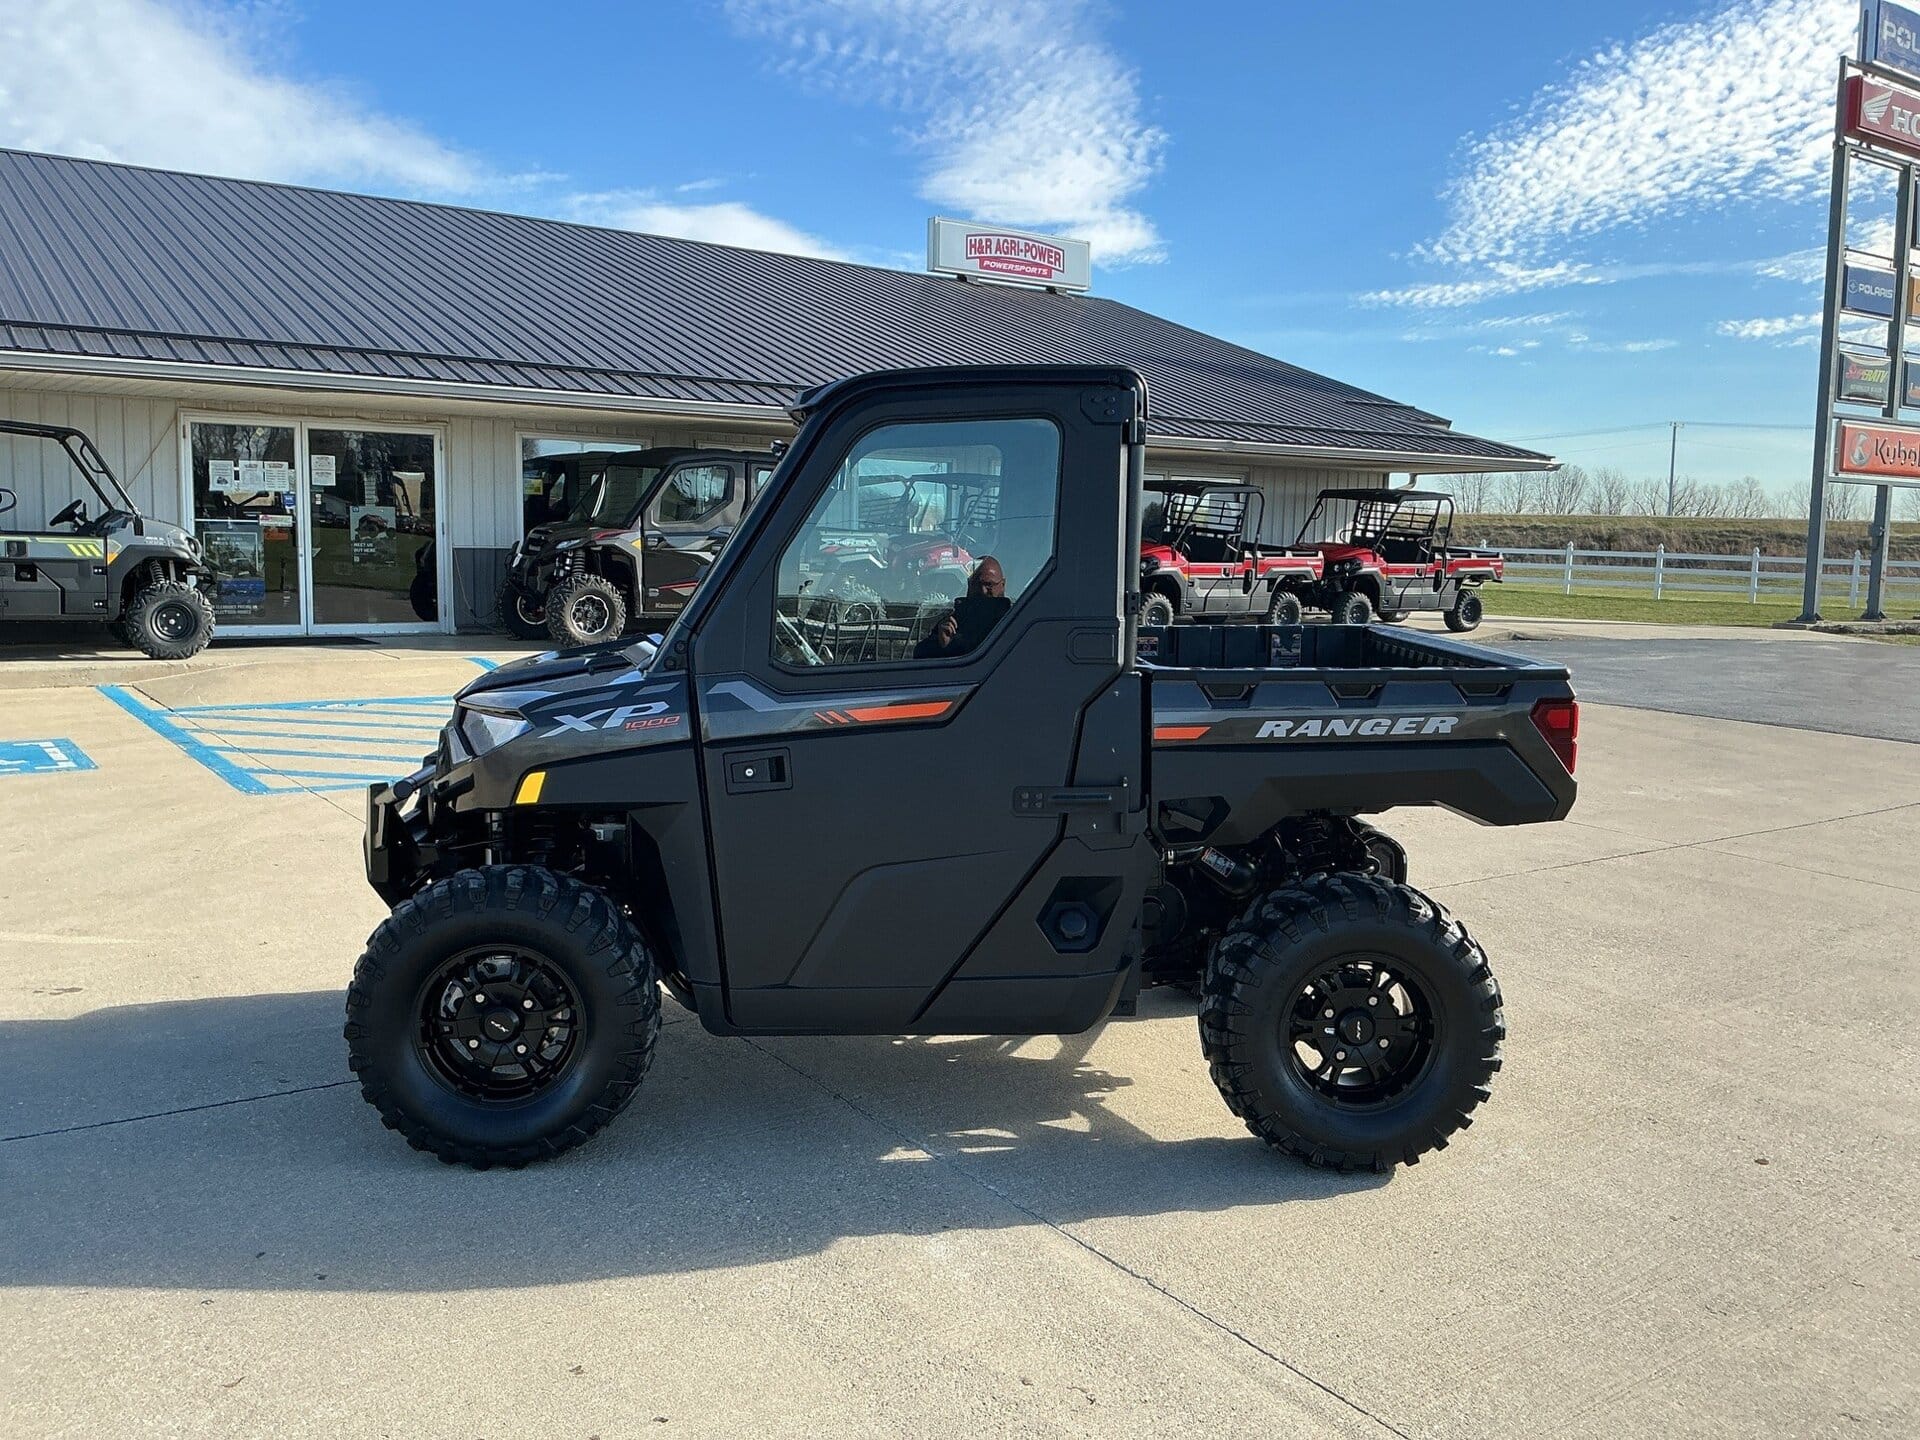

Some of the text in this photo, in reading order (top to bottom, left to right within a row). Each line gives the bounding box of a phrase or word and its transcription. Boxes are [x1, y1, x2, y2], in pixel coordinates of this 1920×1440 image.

[969, 238, 1062, 269] H&R AGRI-POWER
[983, 260, 1048, 275] POWERSPORTS
[1858, 283, 1893, 299] POLARIS
[1875, 436, 1920, 467] Kubo
[537, 701, 670, 739] XP
[624, 715, 680, 730] 1000
[1255, 716, 1459, 738] RANGER
